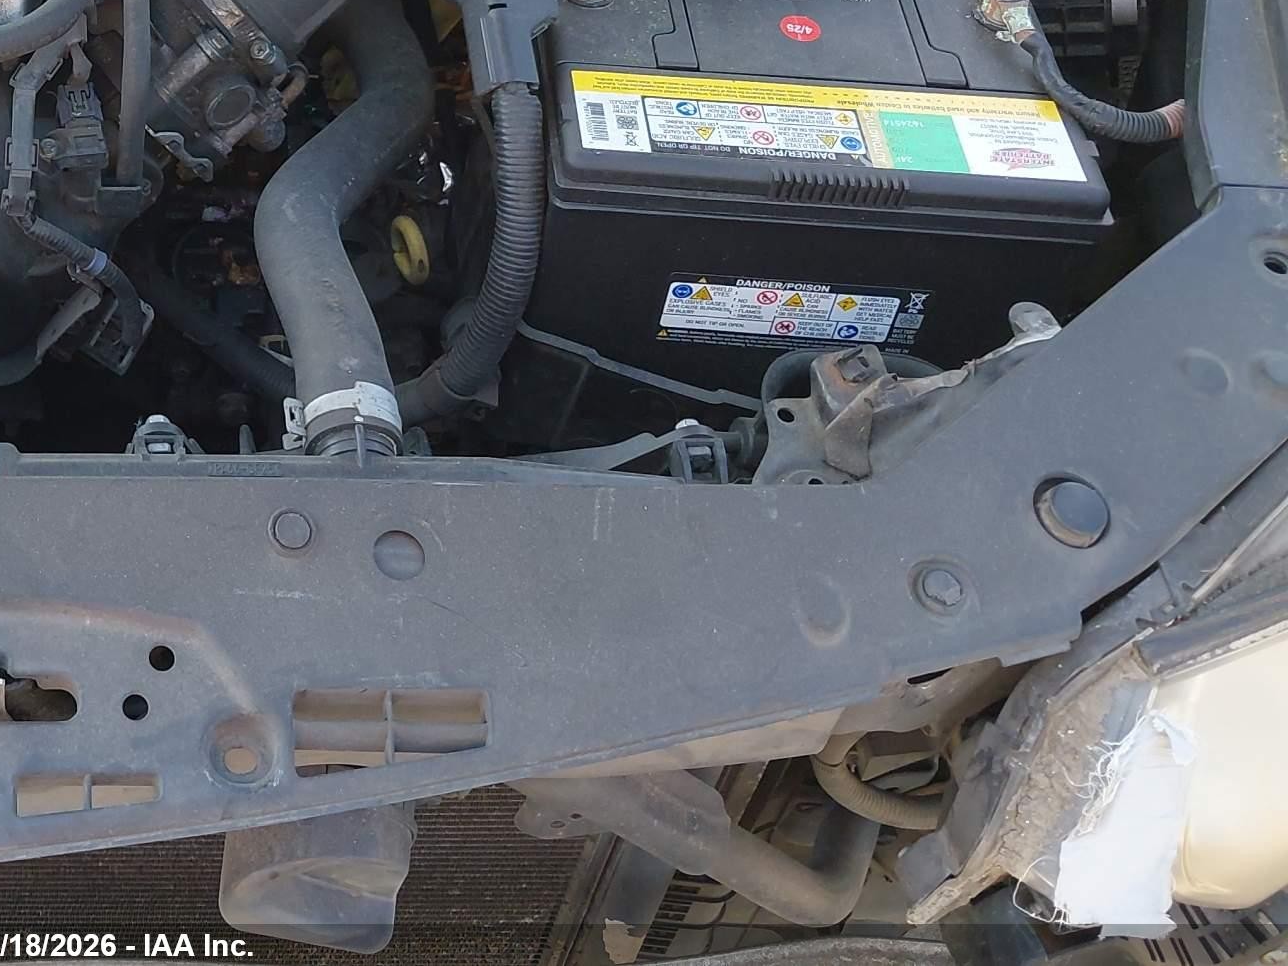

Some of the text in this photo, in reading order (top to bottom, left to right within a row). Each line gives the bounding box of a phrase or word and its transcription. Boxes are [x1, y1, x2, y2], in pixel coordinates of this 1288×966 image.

[786, 22, 814, 34] 4/25
[835, 99, 875, 107] Wholesale
[911, 103, 946, 112] batteries
[980, 107, 1014, 116] warranty
[737, 146, 837, 160] DANGER/POISON
[990, 149, 1053, 160] BATTERIES
[987, 154, 1057, 166] INTERSTATE
[735, 278, 831, 292] DANGER/POISON
